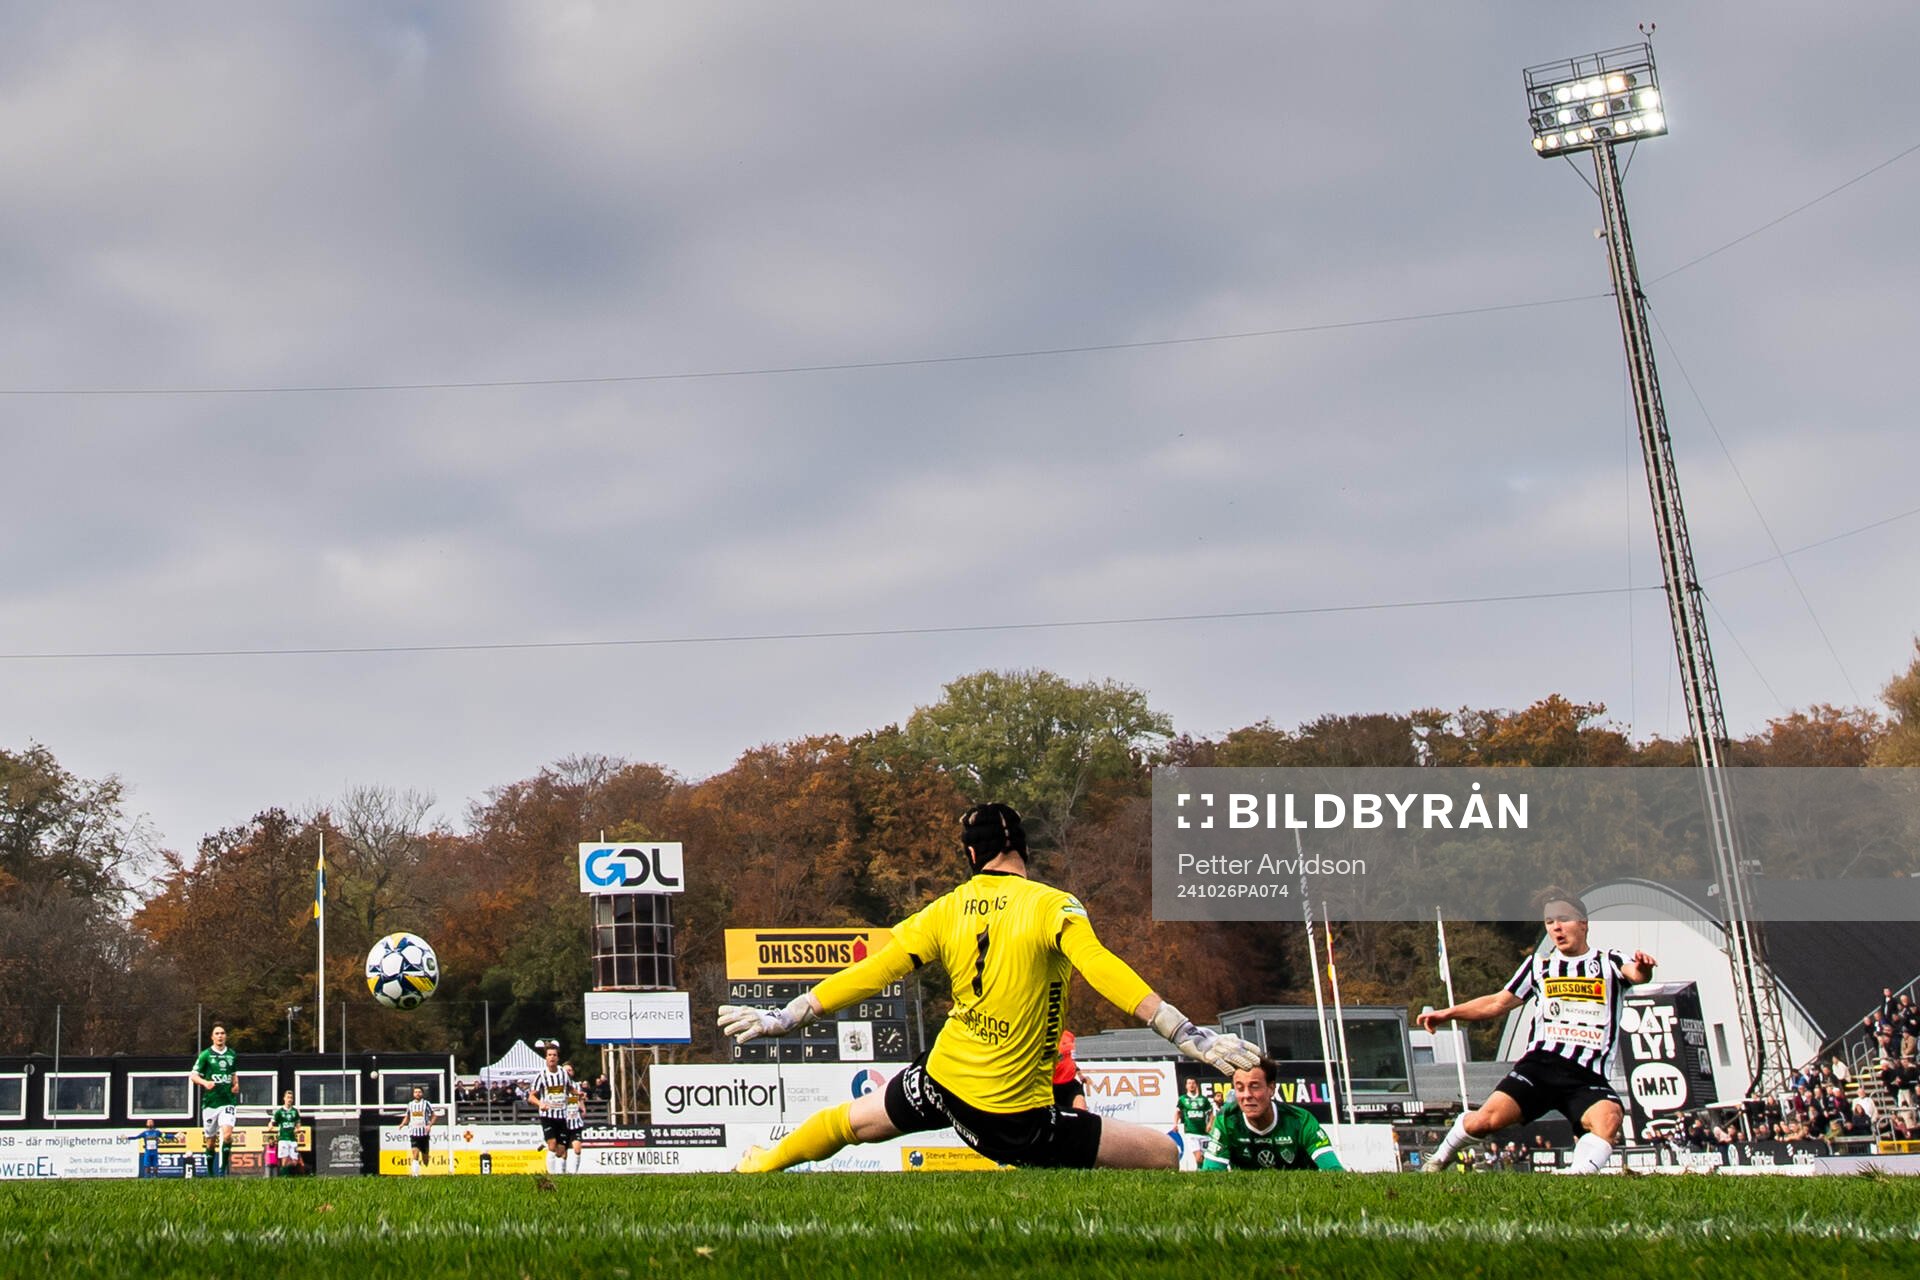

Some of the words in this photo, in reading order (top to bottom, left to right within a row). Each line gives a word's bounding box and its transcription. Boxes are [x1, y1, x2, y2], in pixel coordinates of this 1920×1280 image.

[585, 848, 679, 887] GDL
[964, 895, 1008, 916] FROIG
[758, 943, 851, 964] OHLSSONS
[1547, 983, 1594, 995] OHLSSONS
[591, 1010, 685, 1022] BORGWARNER
[665, 1079, 777, 1114] granitor
[1637, 1077, 1678, 1097] iMAT
[0, 1137, 15, 1147] SB
[45, 1136, 113, 1148] möjligheterna
[0, 1157, 57, 1176] WEDEL
[601, 1152, 634, 1166] EKEBY
